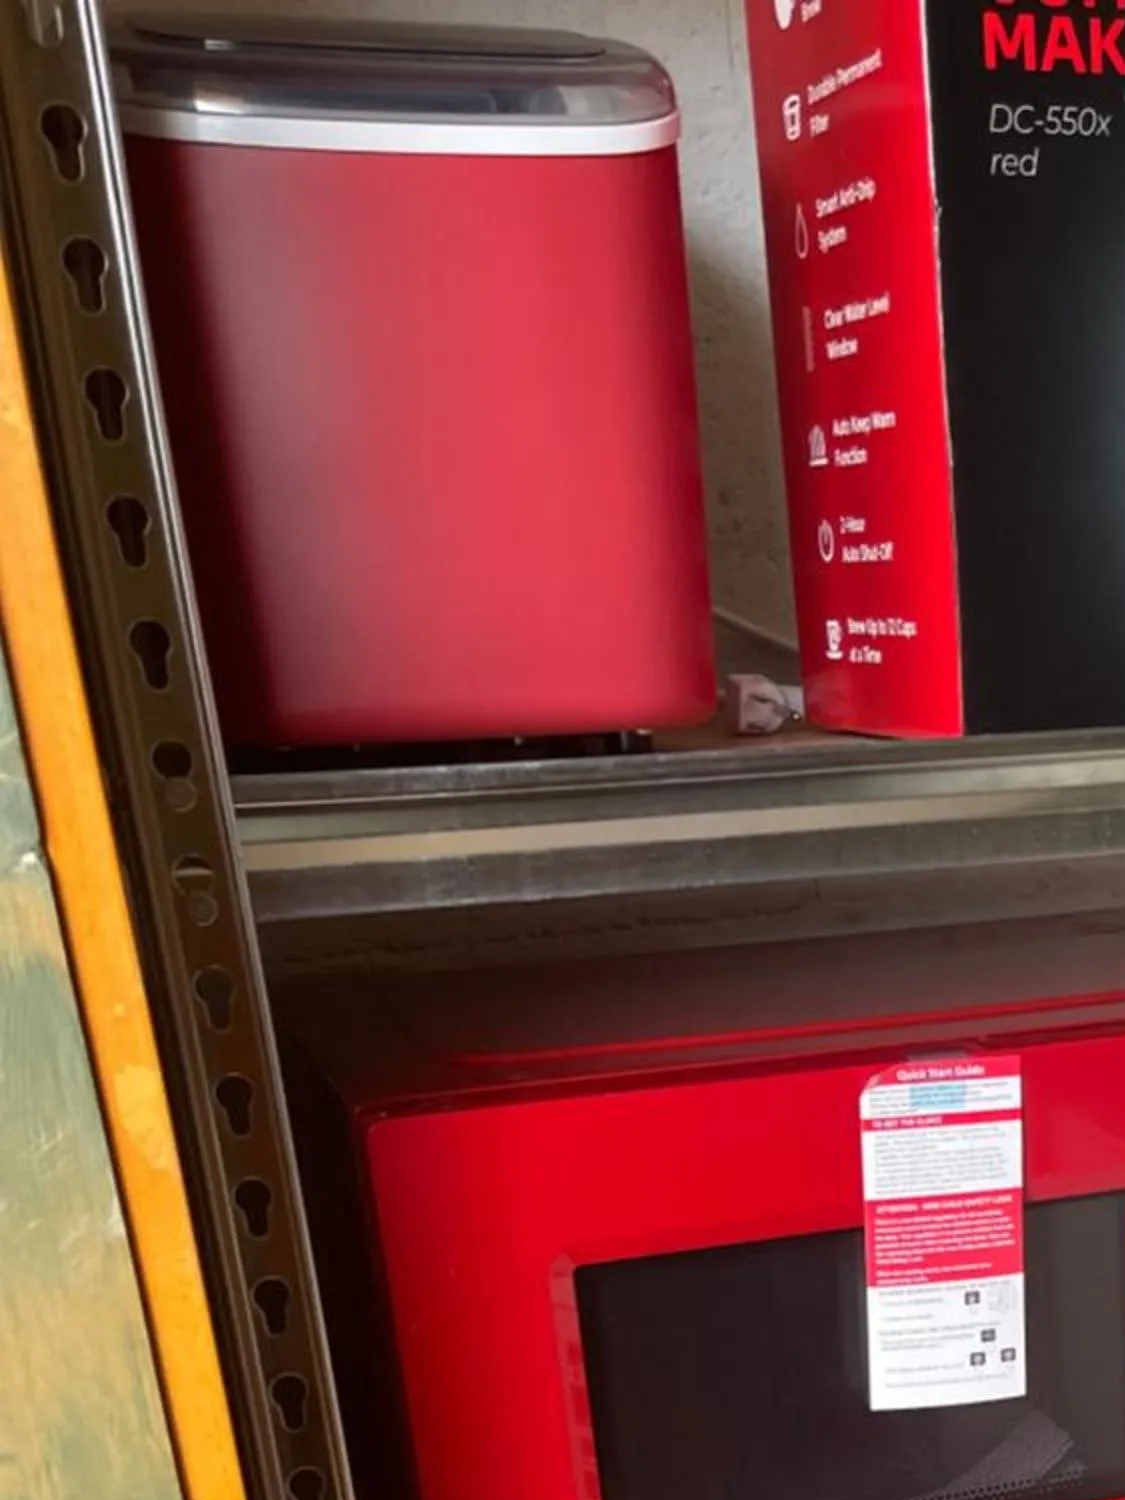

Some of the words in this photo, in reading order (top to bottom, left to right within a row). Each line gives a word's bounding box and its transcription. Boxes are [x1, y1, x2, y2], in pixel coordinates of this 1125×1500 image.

[989, 103, 1112, 137] DC-550x
[990, 147, 1039, 176] red
[896, 1069, 926, 1081] Quick
[927, 1066, 953, 1079] Start
[953, 1064, 985, 1077] Guide
